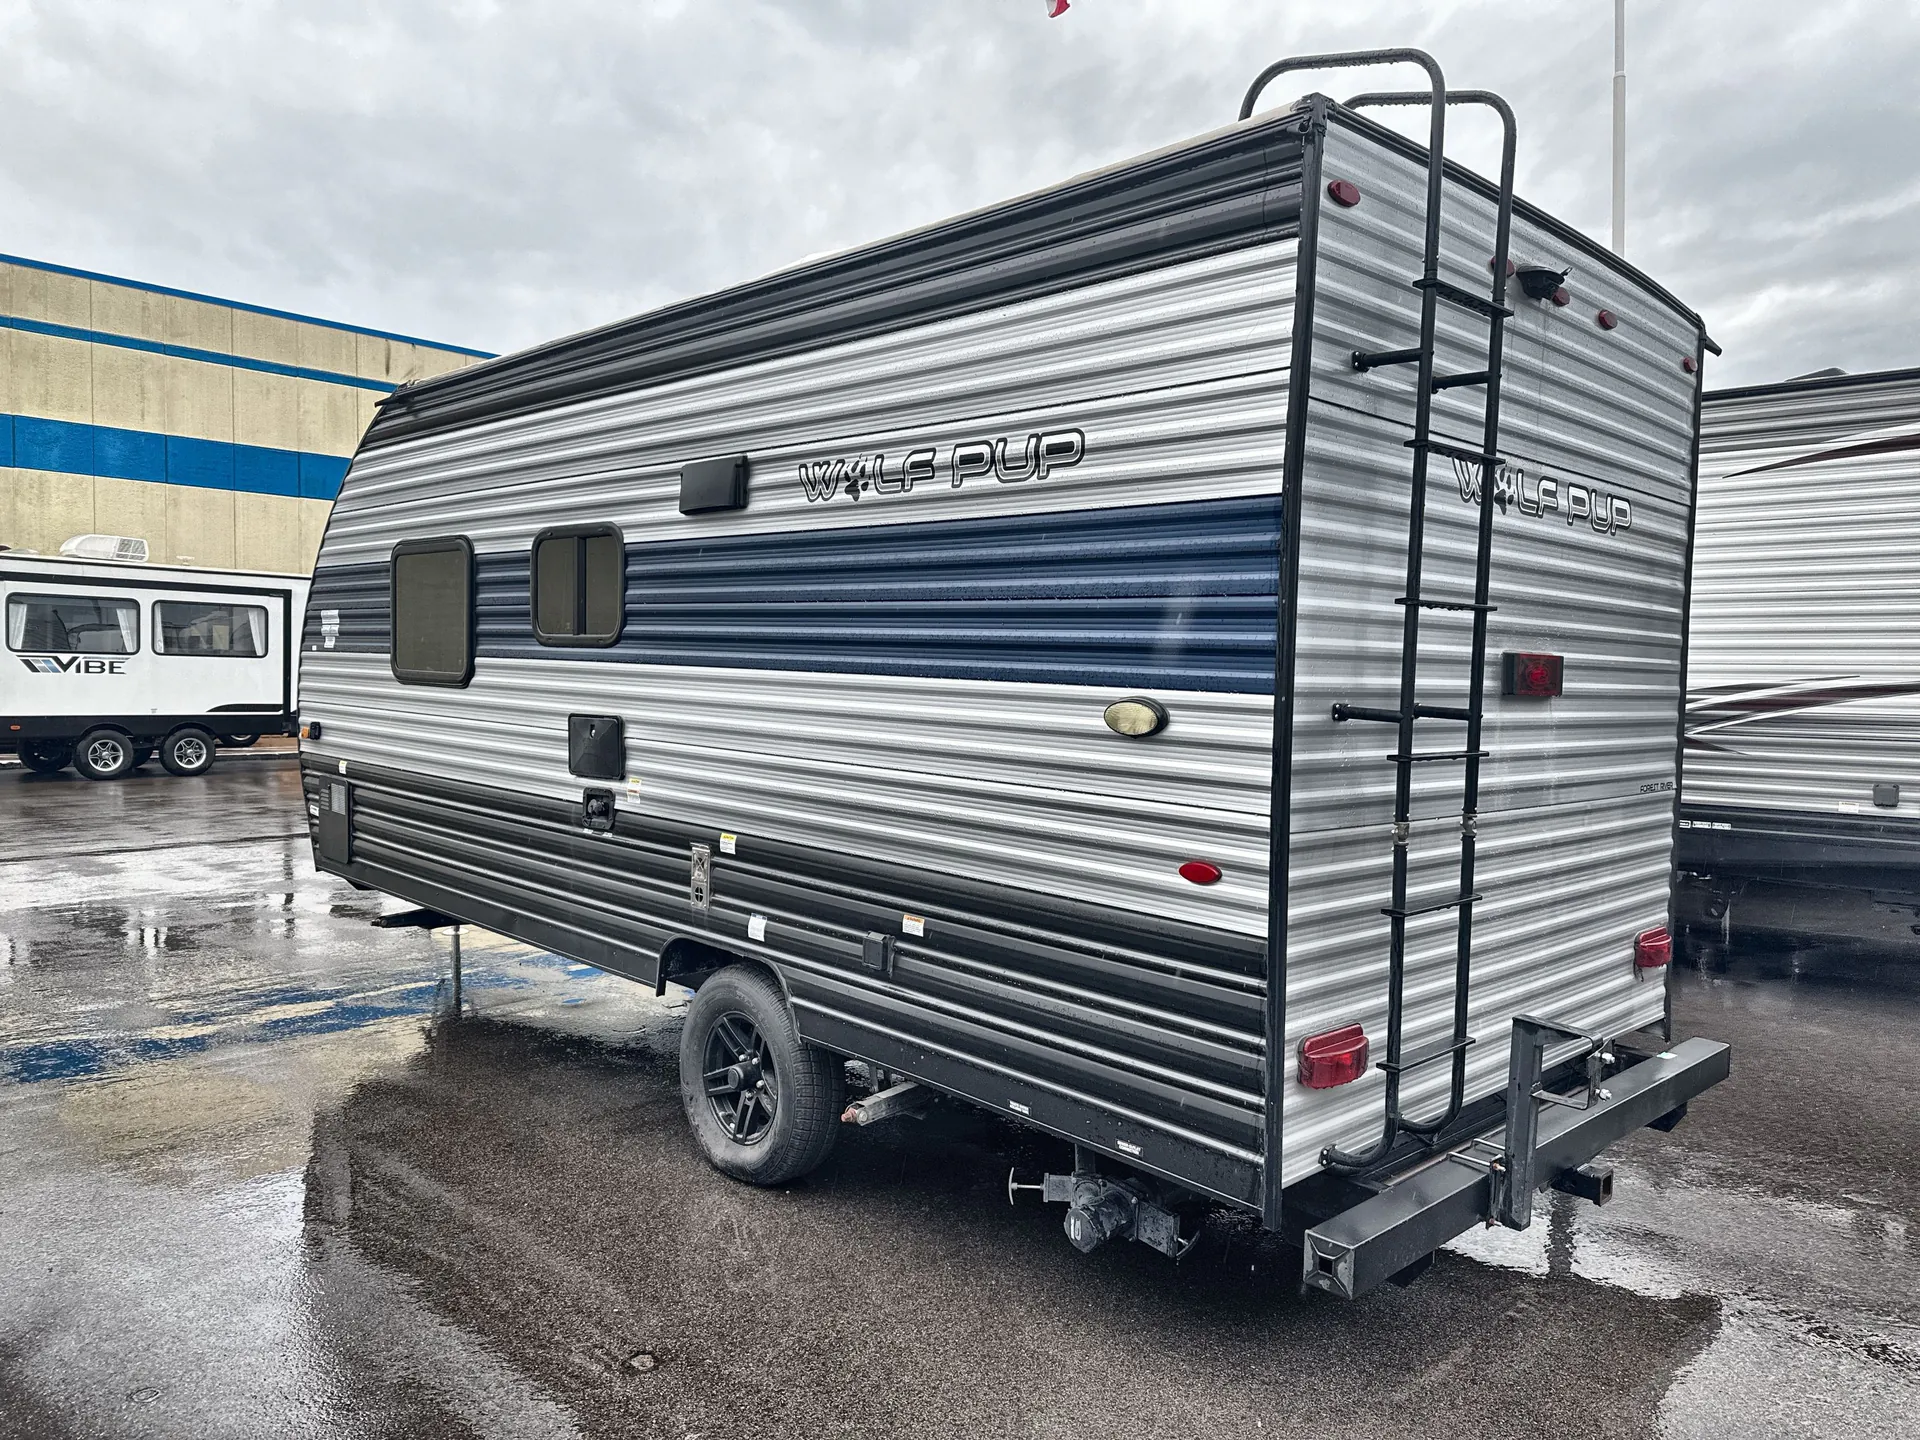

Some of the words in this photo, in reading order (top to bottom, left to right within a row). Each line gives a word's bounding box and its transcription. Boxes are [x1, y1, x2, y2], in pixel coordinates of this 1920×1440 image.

[951, 428, 1086, 489] PUP
[1567, 482, 1632, 536] PUP
[50, 655, 127, 675] VIBE
